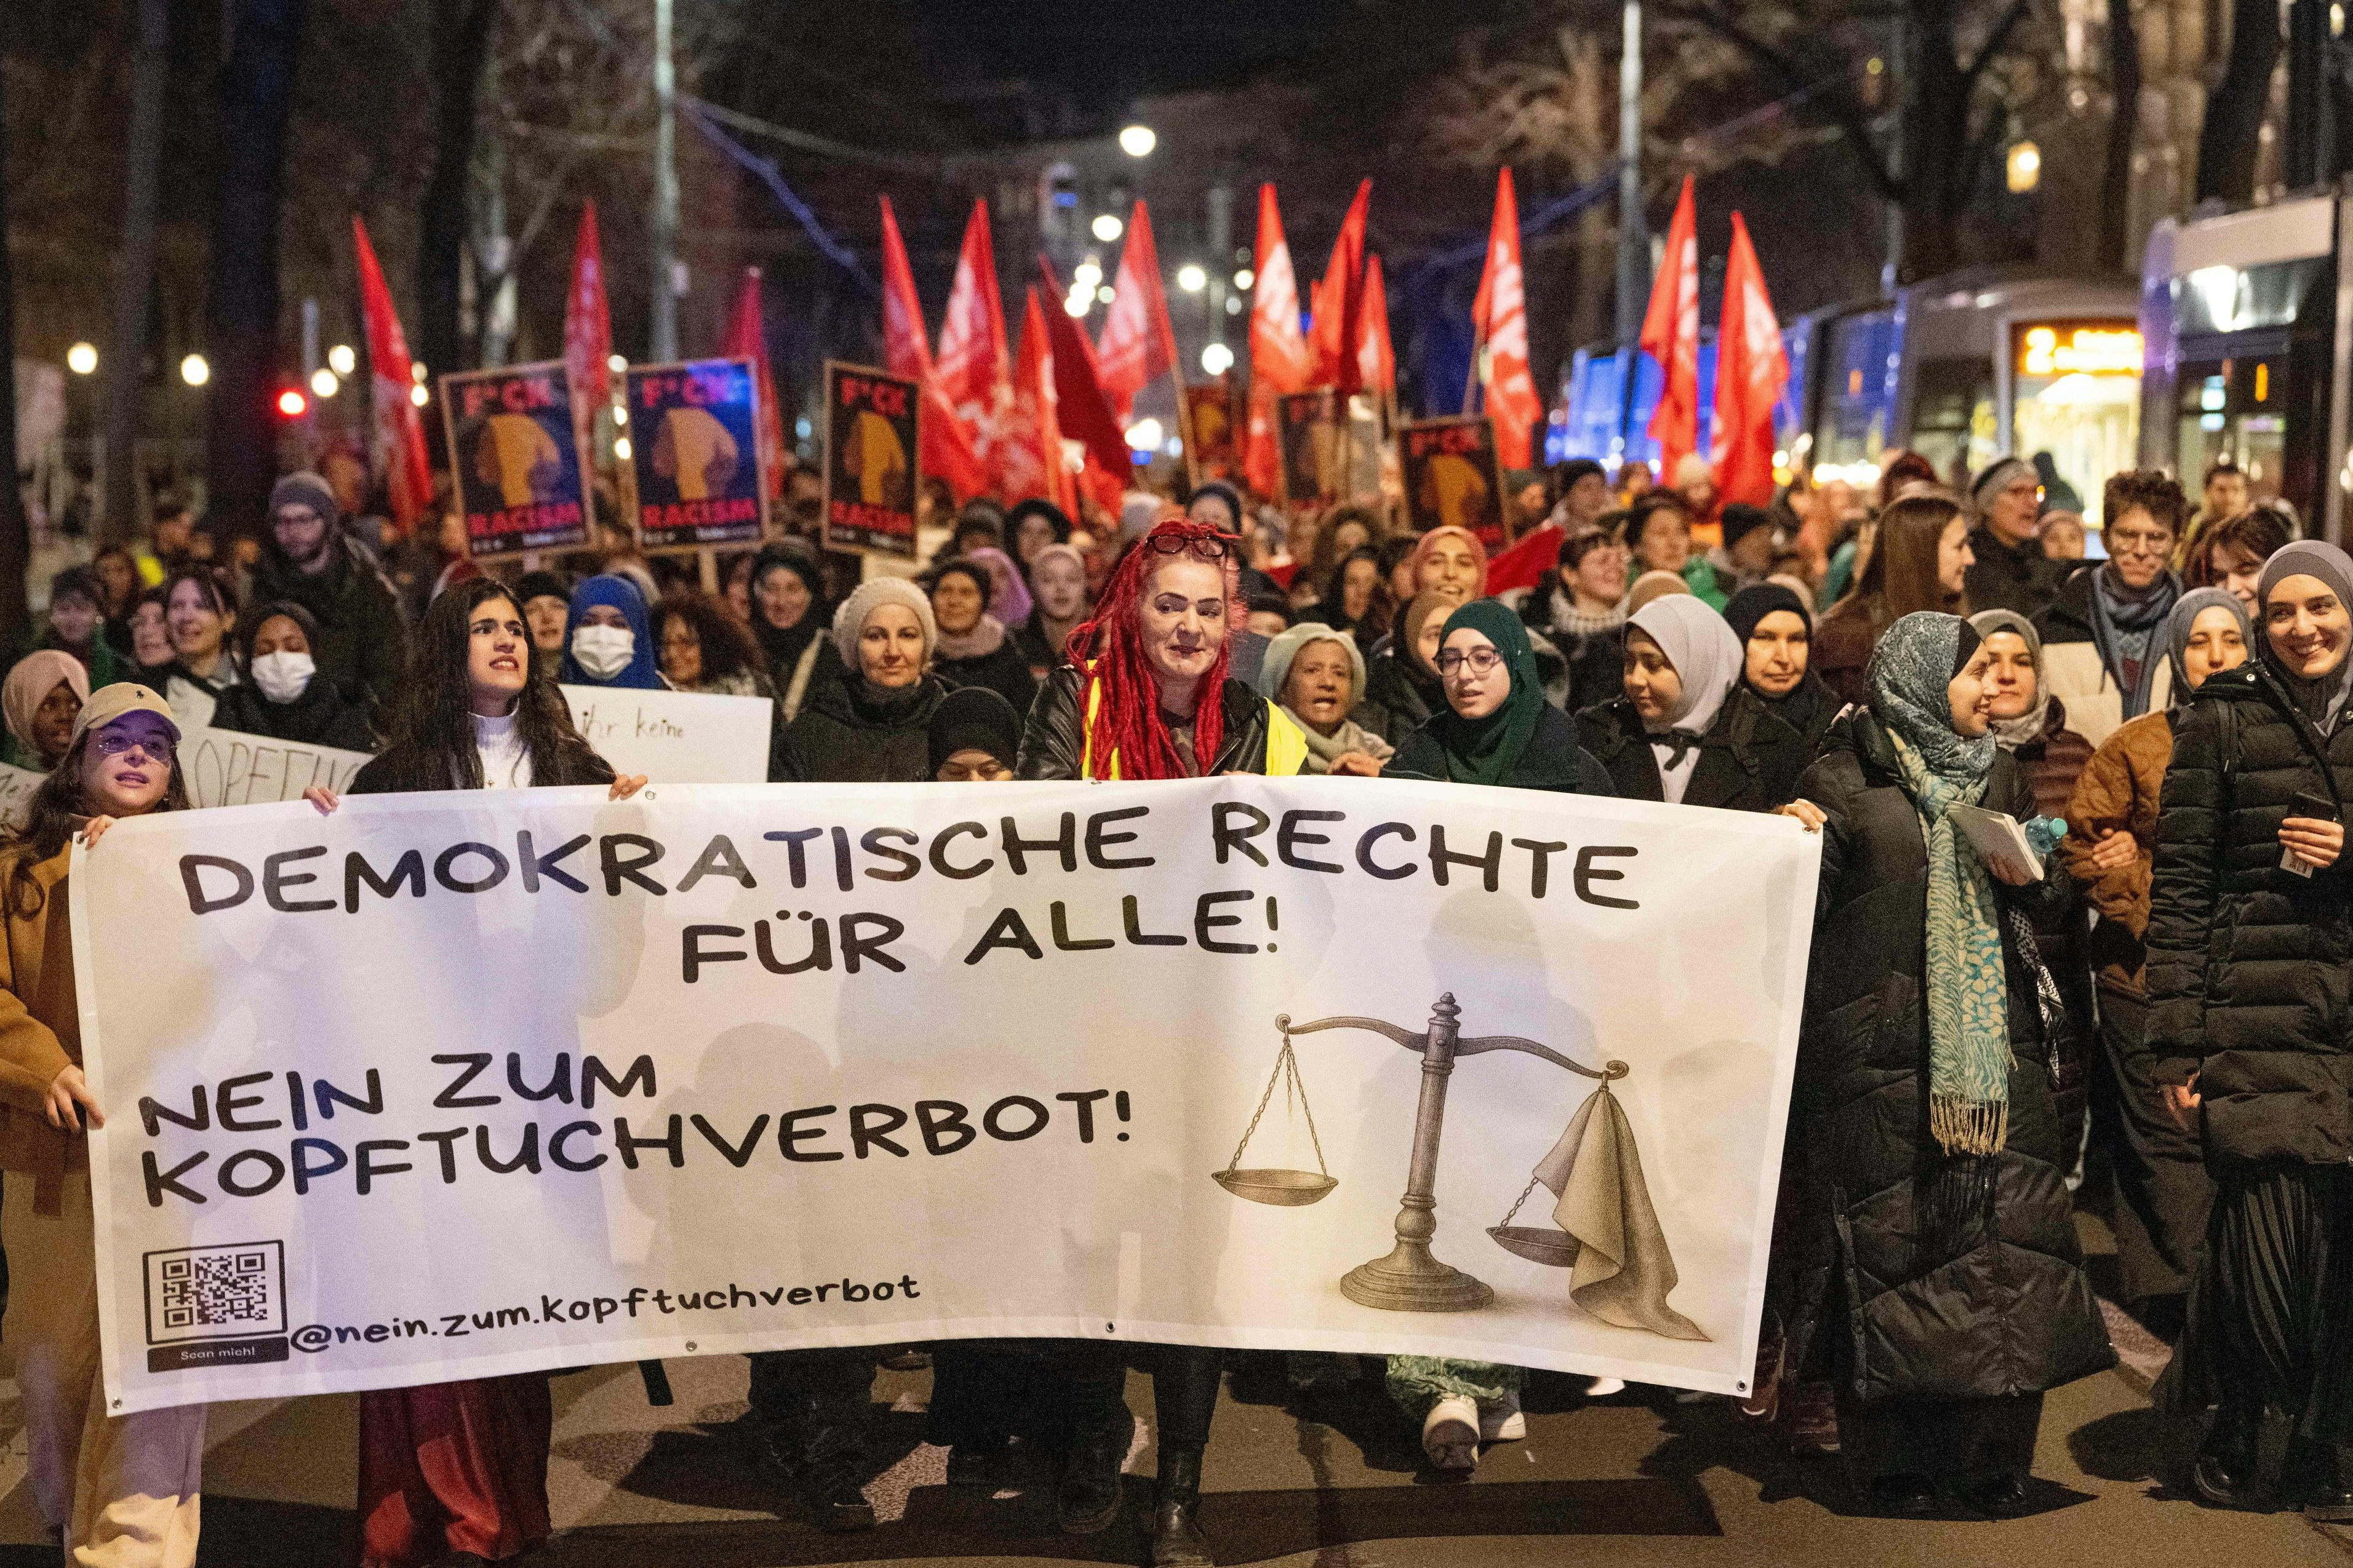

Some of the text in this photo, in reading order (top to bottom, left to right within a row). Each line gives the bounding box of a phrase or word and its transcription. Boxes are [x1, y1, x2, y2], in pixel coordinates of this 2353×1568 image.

[636, 707, 684, 739] keine
[178, 802, 1638, 915] DEMOKRATISCHE RECHTE
[682, 890, 1280, 984] FÜR ALLE!
[139, 1052, 657, 1137] NEIN ZUM
[141, 1089, 1131, 1208] KOPFTUCHVERBOT!
[180, 1346, 255, 1361] Scan mich!
[289, 1274, 921, 1353] @nein.zum.kopftuchverbot
